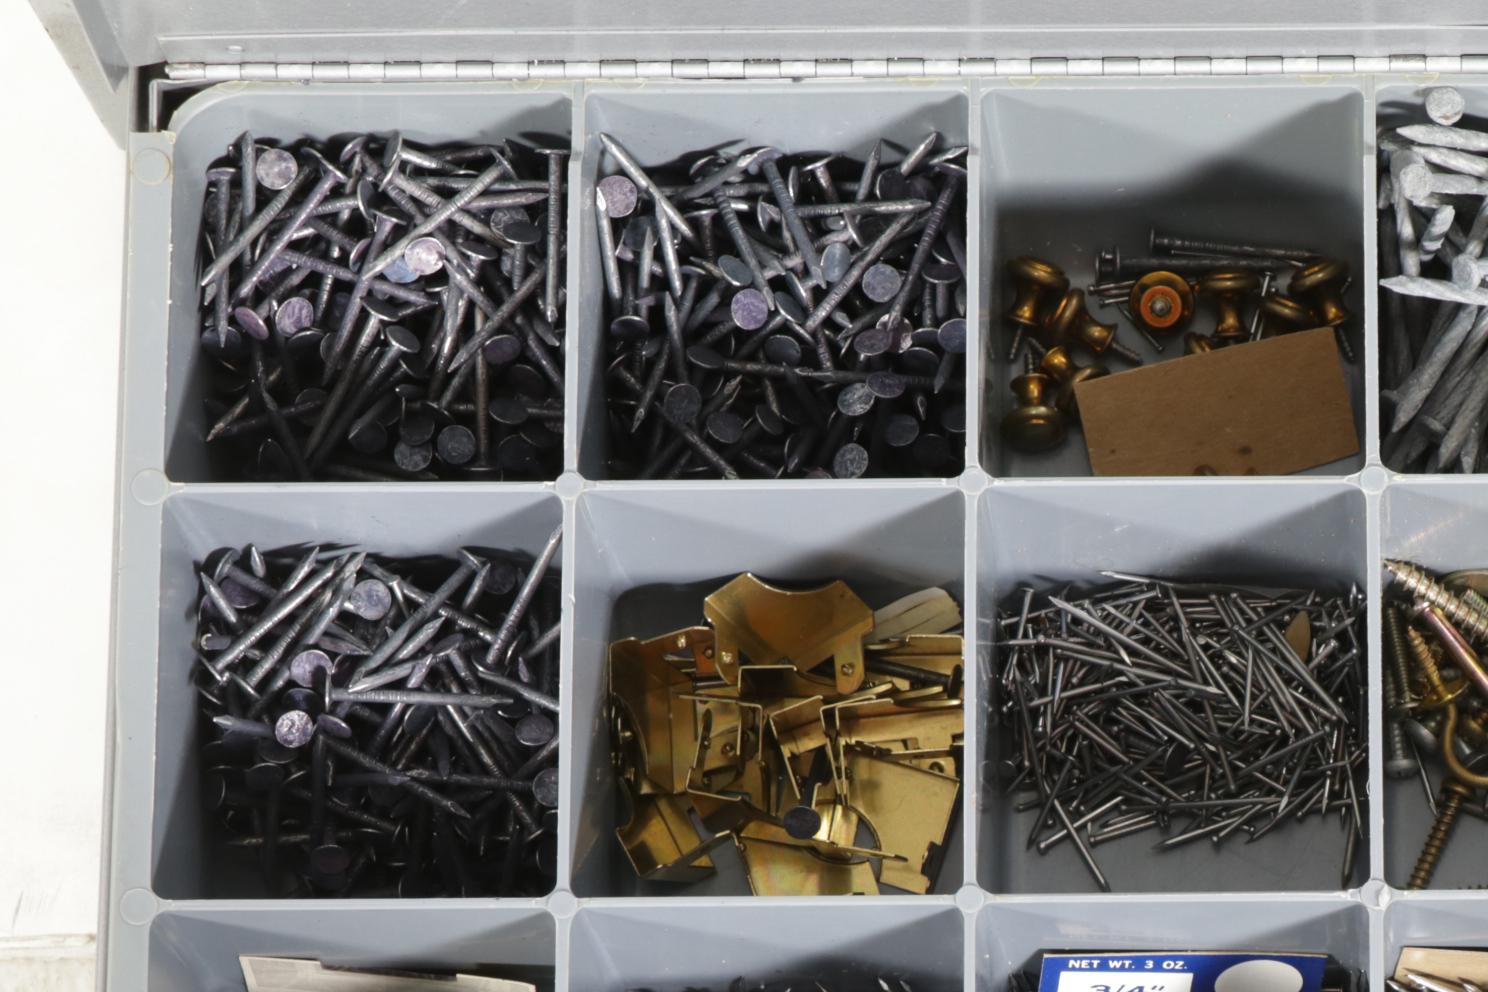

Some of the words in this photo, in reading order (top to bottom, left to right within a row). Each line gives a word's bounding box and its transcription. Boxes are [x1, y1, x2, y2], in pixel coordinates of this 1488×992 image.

[1068, 959, 1100, 969] NET
[1108, 959, 1135, 970] WT.
[1144, 960, 1154, 970] 3
[1162, 959, 1188, 970] OZ.
